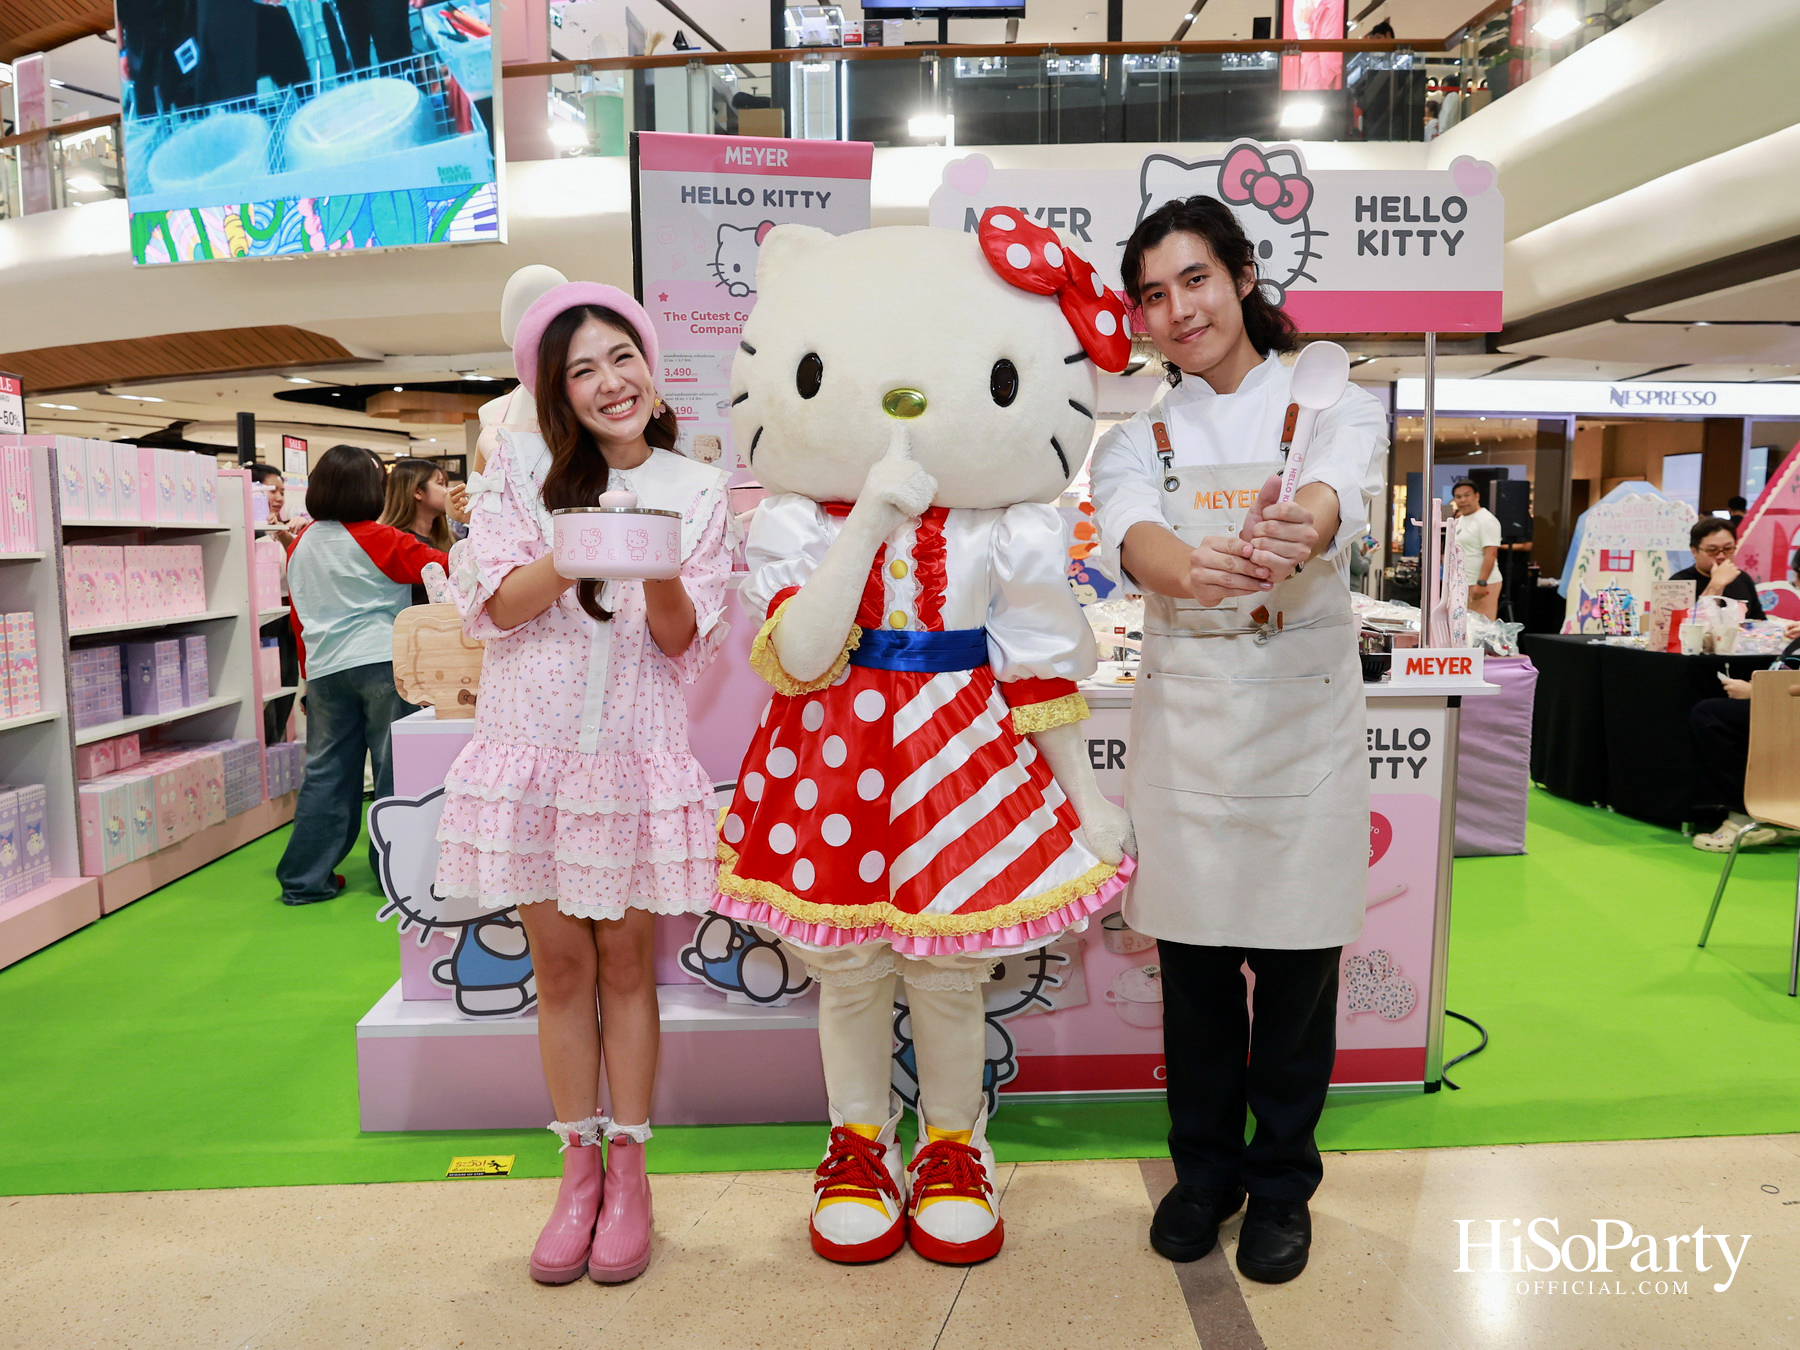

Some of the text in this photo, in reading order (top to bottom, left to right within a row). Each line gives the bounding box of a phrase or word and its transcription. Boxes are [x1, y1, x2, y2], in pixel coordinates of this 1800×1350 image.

[725, 146, 789, 167] MEYER
[681, 186, 832, 209] HELLO KITTY
[1355, 196, 1468, 223] HELLO
[1357, 229, 1465, 256] KITTY
[663, 312, 687, 321] The
[690, 311, 730, 321] Cutest
[690, 324, 743, 336] Compani
[664, 367, 692, 378] 3,490
[1609, 386, 1717, 408] NESPRESSO
[1285, 467, 1298, 493] HELLO
[1405, 657, 1472, 675] MEYER
